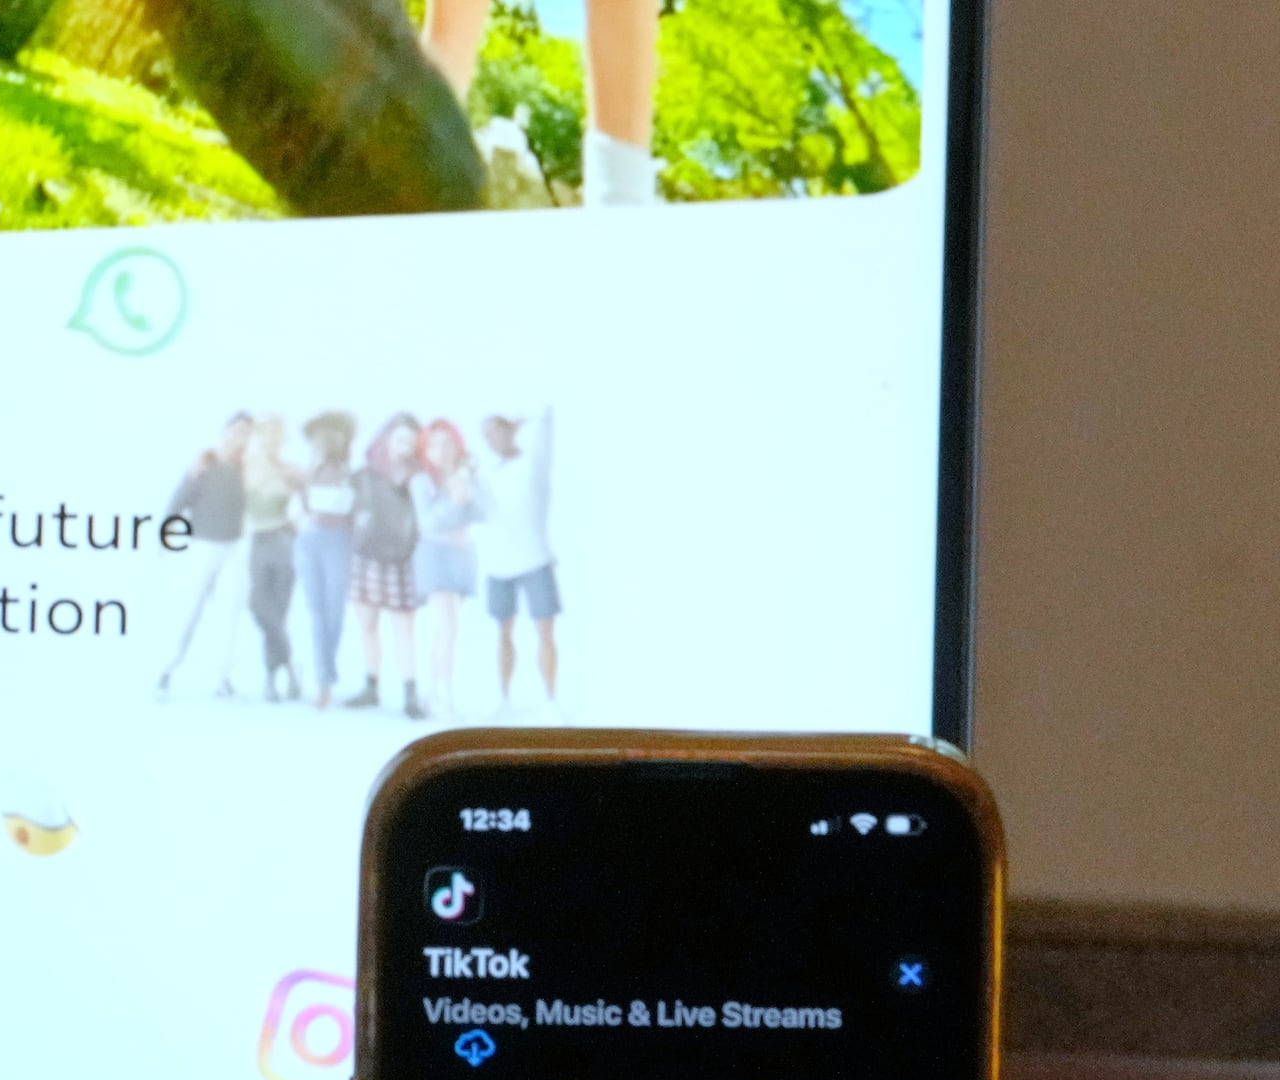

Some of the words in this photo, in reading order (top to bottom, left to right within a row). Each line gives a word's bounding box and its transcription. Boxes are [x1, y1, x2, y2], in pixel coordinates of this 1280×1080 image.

[459, 808, 531, 832] 12:34
[423, 948, 530, 980] TikTok
[423, 999, 529, 1029] Videos,
[536, 1000, 622, 1027] Music
[628, 1001, 650, 1026] &
[657, 1001, 716, 1028] Live
[721, 1003, 842, 1030] Streams
